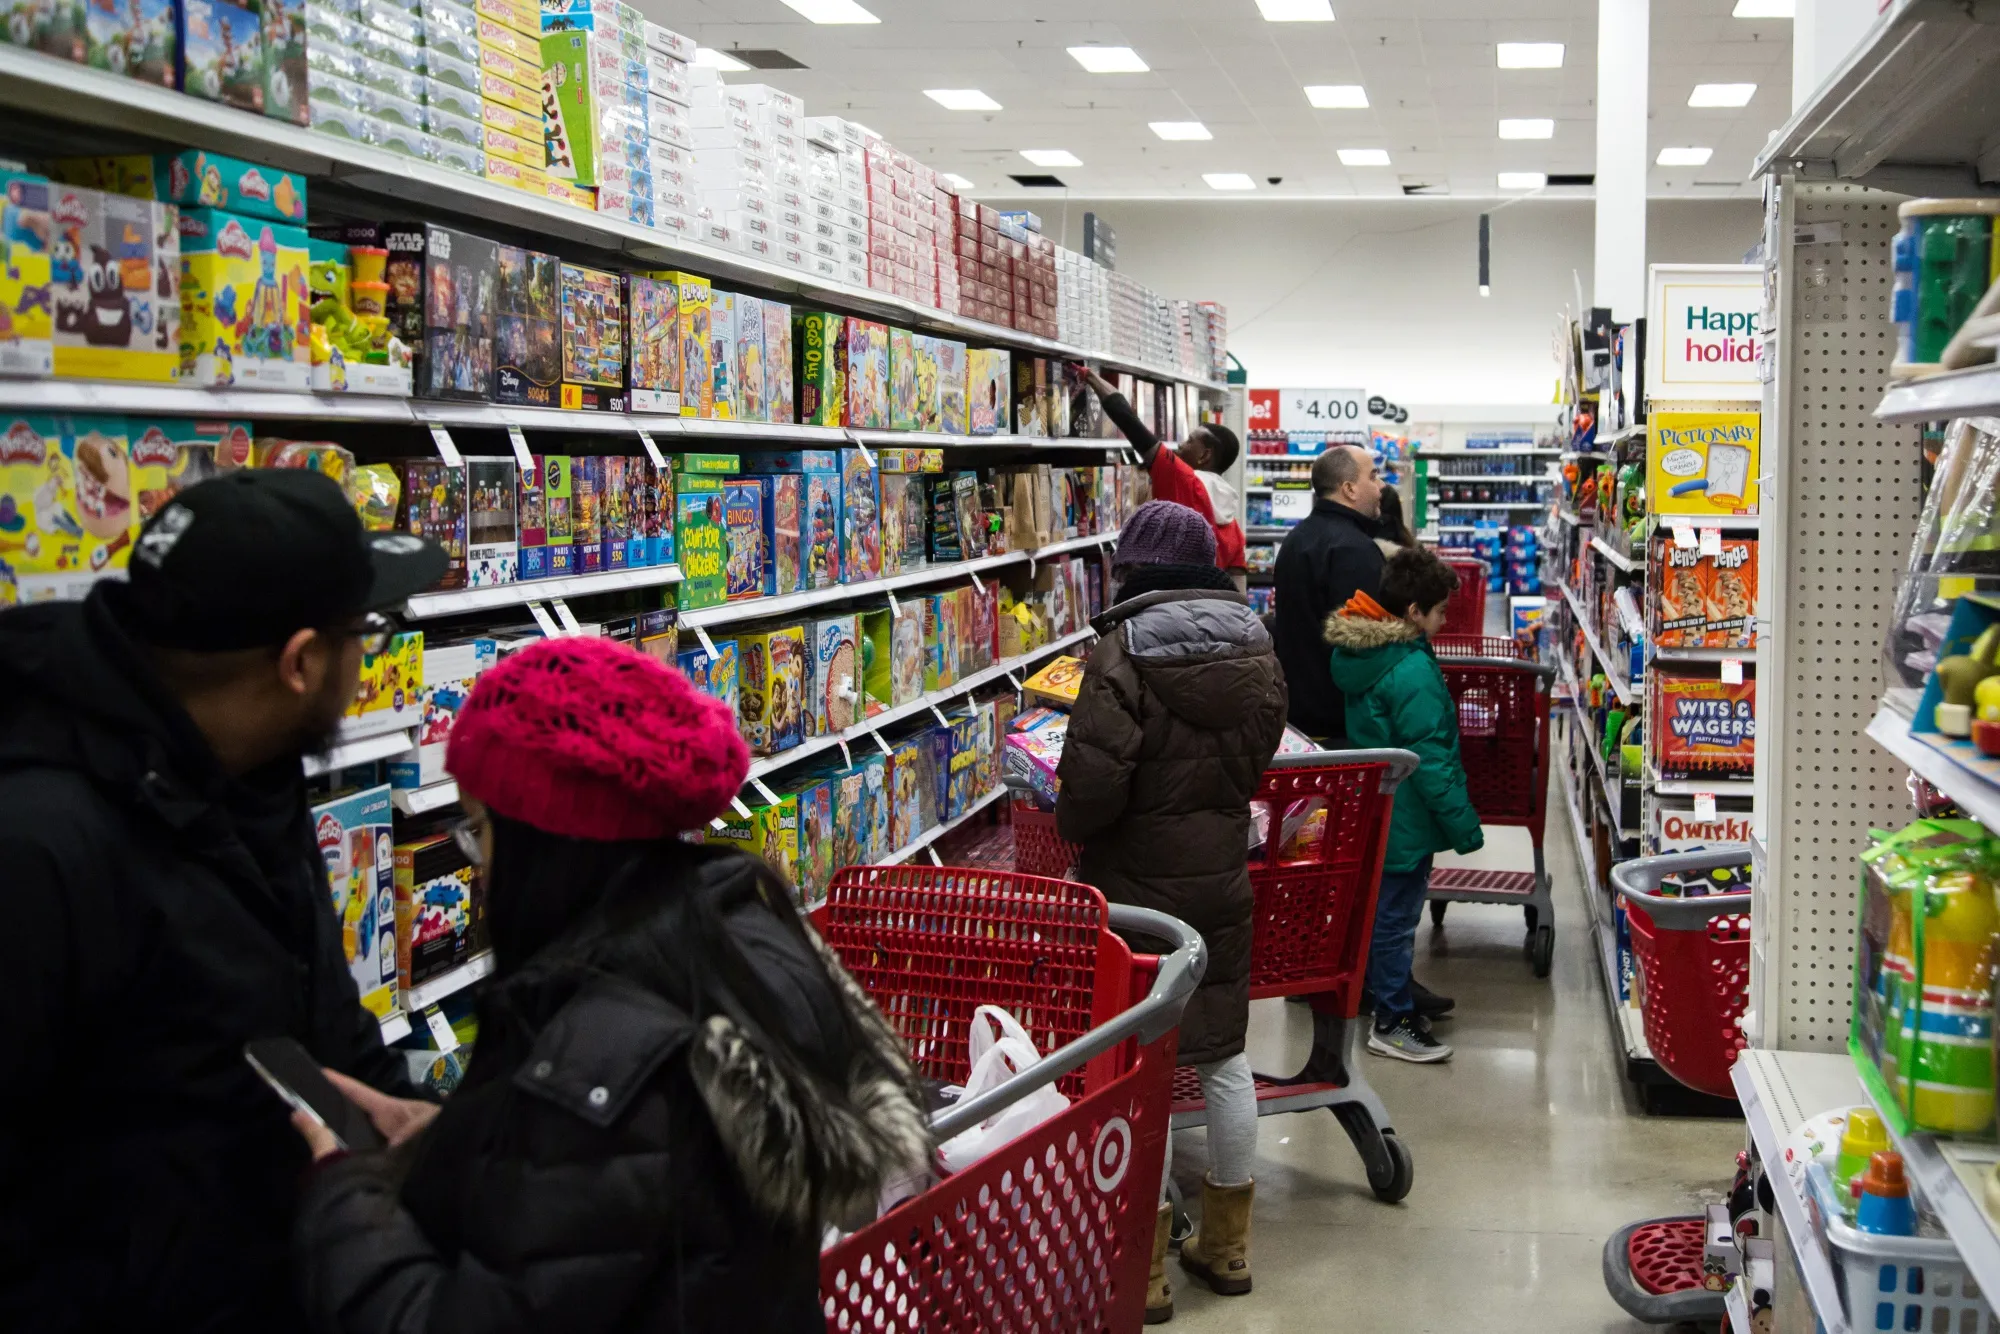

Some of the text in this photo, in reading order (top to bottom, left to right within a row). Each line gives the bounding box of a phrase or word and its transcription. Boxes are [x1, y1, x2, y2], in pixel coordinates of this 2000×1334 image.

[347, 228, 376, 238] 2000
[389, 232, 424, 243] STAR
[430, 230, 450, 244] STAR
[385, 240, 424, 252] WARS
[429, 242, 450, 259] WARS
[1687, 306, 1758, 336] Happ
[501, 369, 520, 387] Disney
[610, 398, 623, 411] 1500
[1658, 425, 1756, 446] PICTIONARY
[727, 509, 754, 524] BINGO
[684, 526, 720, 549] COUNT YOUR
[554, 546, 569, 555] PARIS
[613, 541, 625, 550] PARIS
[553, 556, 566, 568] 550
[612, 551, 622, 561] 550
[1669, 546, 1703, 567] Jenga
[1712, 545, 1748, 568] Jenga
[686, 552, 719, 580] CHICKENS!
[1678, 701, 1749, 717] WITS &
[1672, 719, 1755, 736] WAGERS
[710, 828, 753, 841] FINGER
[1664, 817, 1753, 842] Qwirkl
